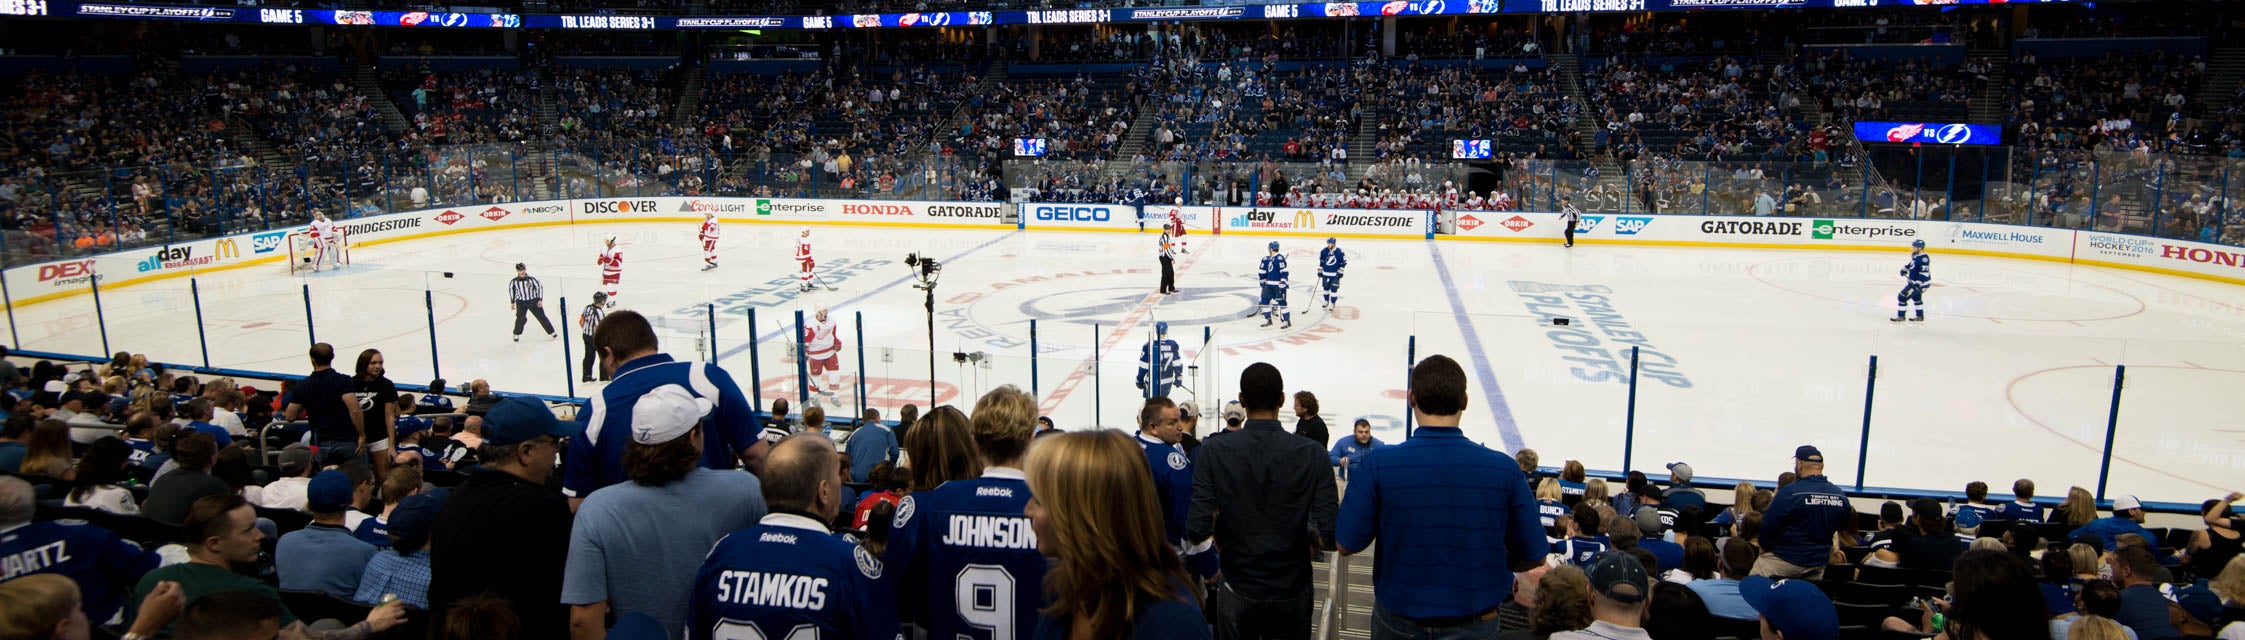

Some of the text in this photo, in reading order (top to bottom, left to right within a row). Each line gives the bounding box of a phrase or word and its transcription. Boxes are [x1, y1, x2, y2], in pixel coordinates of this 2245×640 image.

[27, 0, 47, 15] 3-1
[81, 5, 127, 14] STANLEY
[128, 7, 150, 15] CUP
[150, 8, 200, 16] PLAYOFFS
[1264, 5, 1299, 18] GAME 5
[1541, 0, 1645, 12] TBL LEADS SERIES 3-1
[261, 9, 303, 23] GAME 5
[1027, 9, 1111, 24] TBL LEADS SERIES 3-1
[1183, 9, 1219, 17] PLAYOFFS
[561, 16, 655, 29] TBL LEADS SERIES 3-1
[803, 16, 832, 28] GAME 5
[1924, 128, 1935, 137] VS
[585, 201, 657, 214] DISCOVER
[690, 200, 745, 212] Coors LIGHT
[760, 200, 825, 214] enterprise
[842, 204, 914, 216] HONDA
[927, 205, 1001, 218] GATORADE
[483, 210, 506, 218] ORKIN
[1036, 207, 1110, 222] GEICO
[1231, 209, 1275, 227] all day
[1326, 214, 1414, 227] BRIDGESTONE
[346, 217, 421, 235] BRIDGESTONE
[1455, 219, 1480, 227] ORKIN
[1504, 220, 1529, 228] ORKIN
[1616, 220, 1645, 232] SAP
[1701, 220, 1802, 236] GATORADE
[1818, 221, 1916, 238] enterprise
[253, 235, 281, 251] SAP
[1962, 230, 2009, 241] MAXWELL
[2011, 232, 2044, 244] HOUSE
[2089, 235, 2126, 244] WORLD
[2127, 237, 2148, 246] CUP
[2090, 241, 2154, 254] HOCKEY 2016
[2100, 250, 2141, 258] SEPTEMBER
[137, 246, 192, 272] all day
[164, 255, 214, 269] BREAKFAST
[2160, 244, 2245, 269] HON
[38, 260, 96, 282] DEX
[54, 273, 103, 287] imagig
[724, 259, 892, 315] PLAOFFS
[1565, 292, 1693, 388] STANLEY CUP
[976, 486, 1013, 498] Reebok
[1805, 497, 1844, 507] LIGHTNING
[1540, 505, 1564, 516] BUNCH
[759, 532, 798, 545] Reebok
[942, 514, 1038, 550] JOHNSON
[717, 569, 829, 611] STAMKOS
[955, 563, 1016, 640] 9
